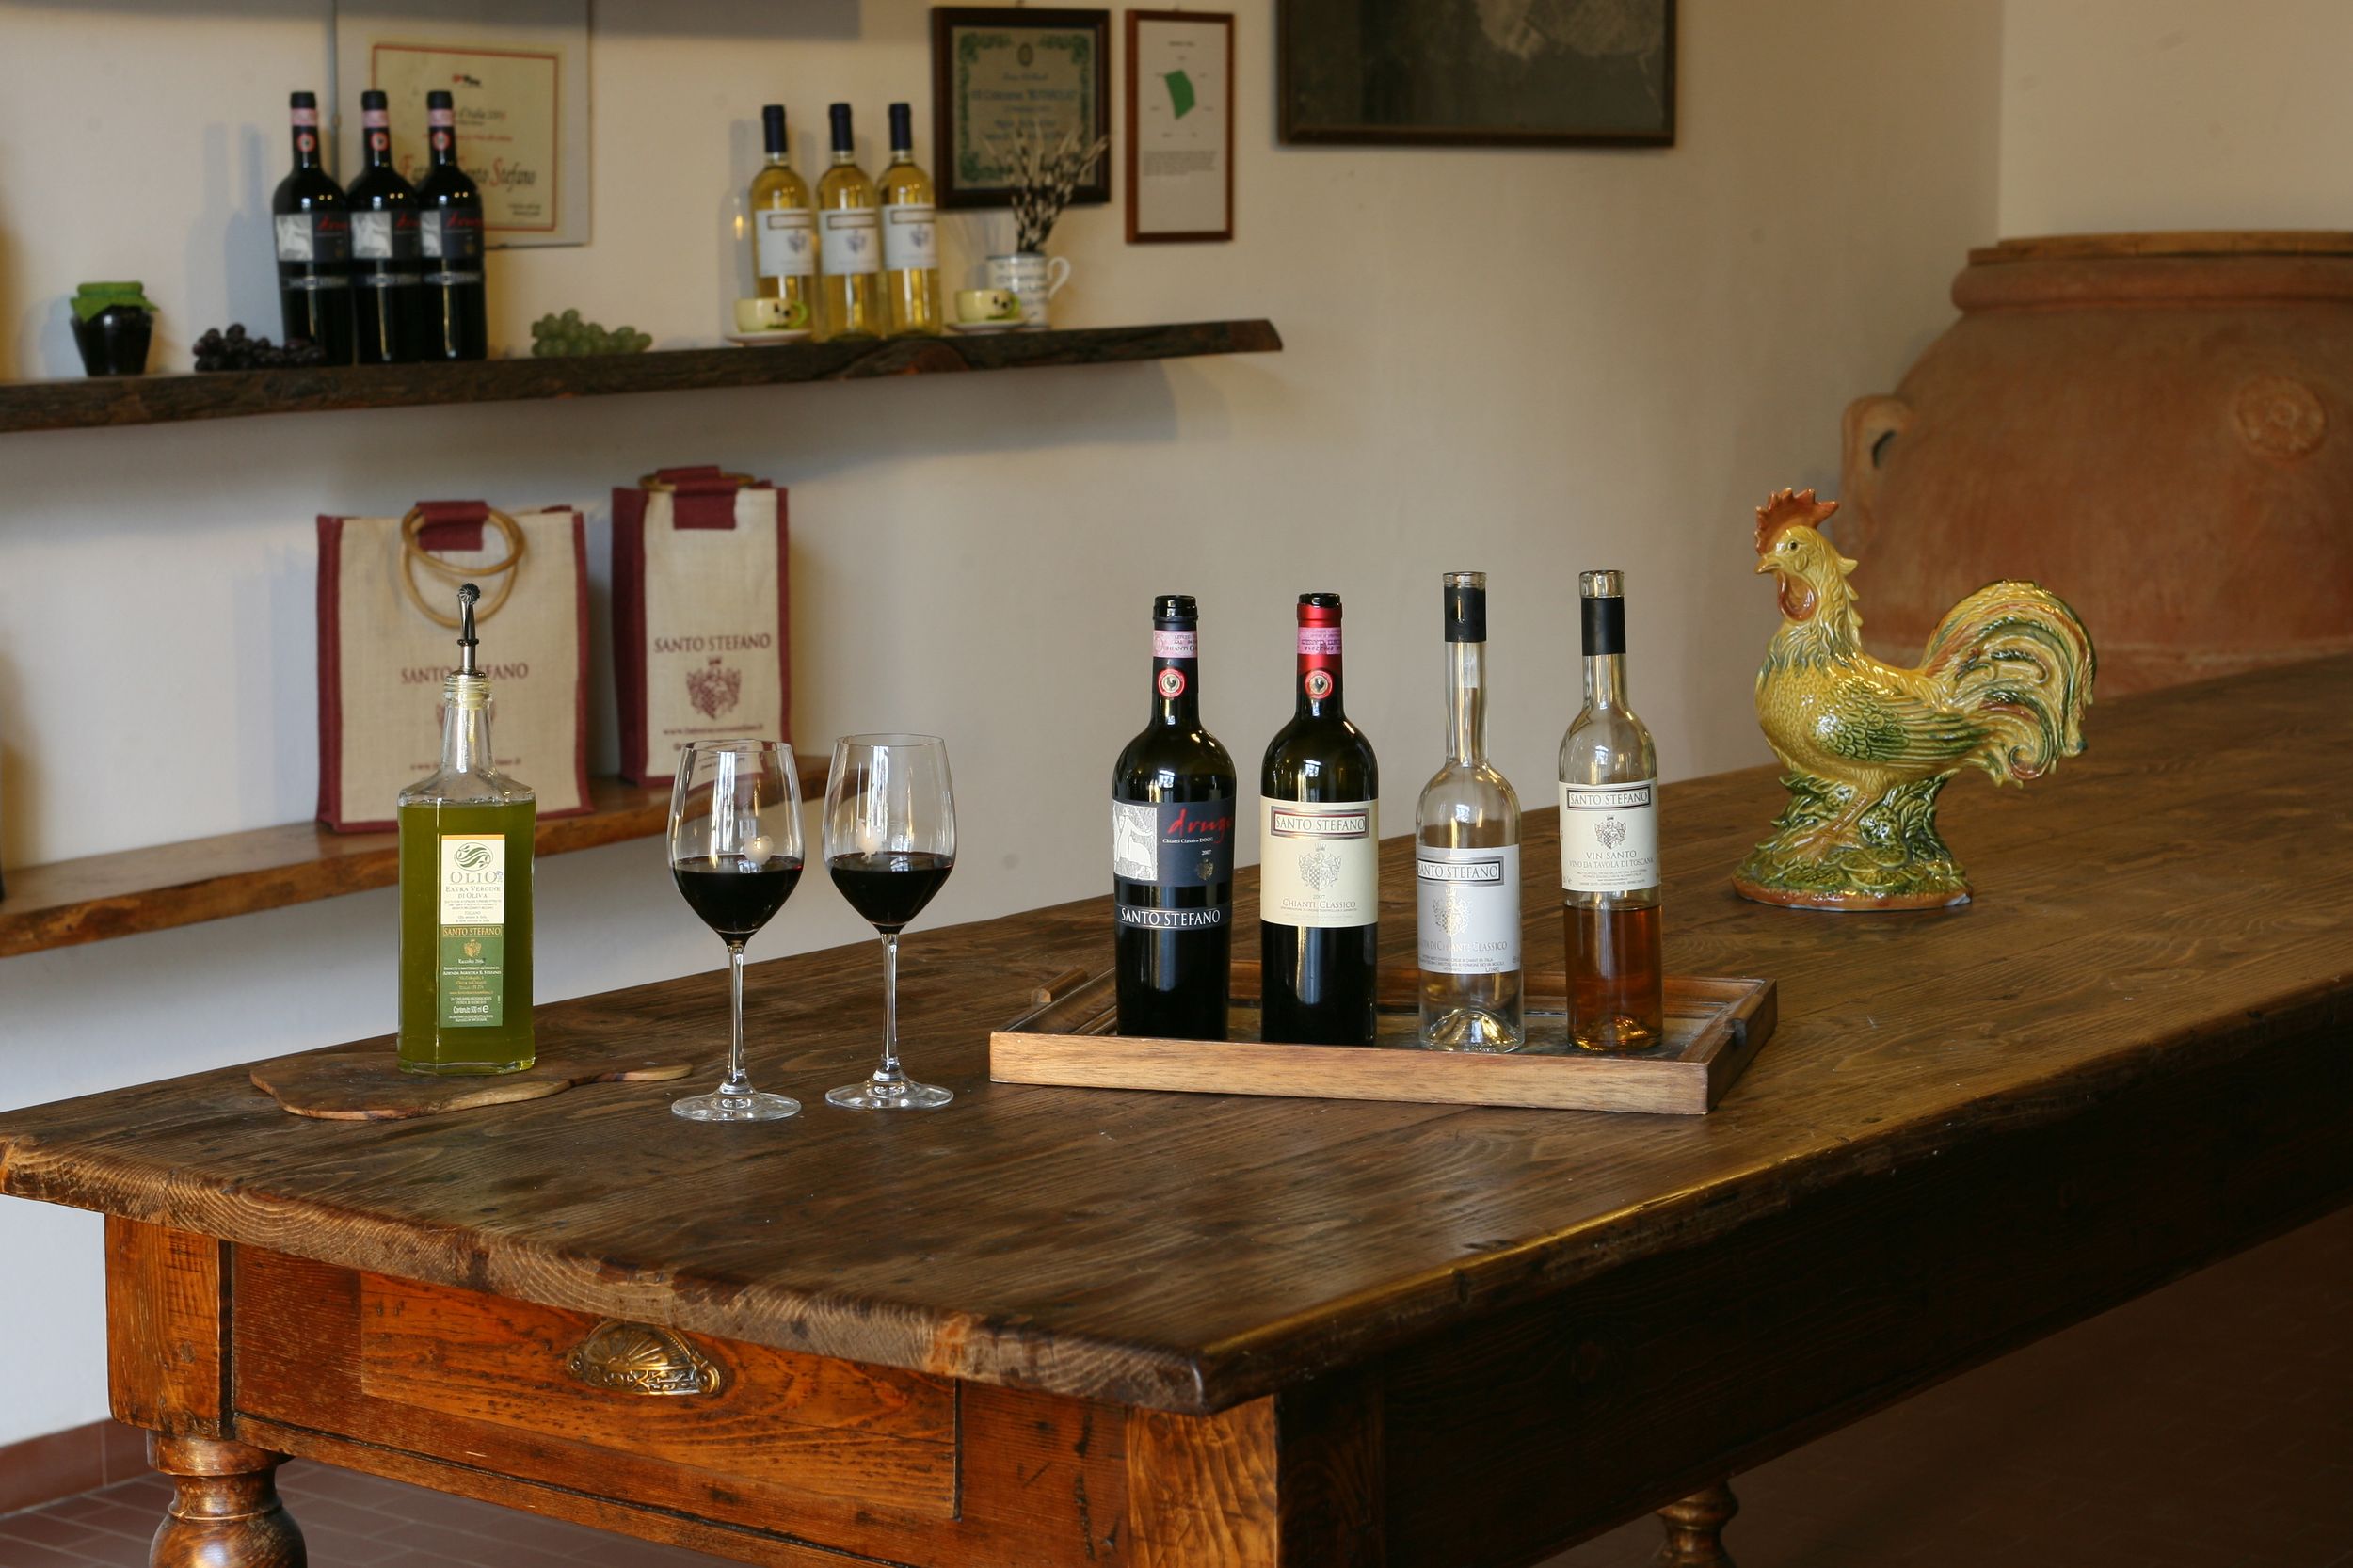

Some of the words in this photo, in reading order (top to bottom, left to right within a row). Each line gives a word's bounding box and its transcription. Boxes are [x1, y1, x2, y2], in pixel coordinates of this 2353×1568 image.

[654, 637, 704, 653] SANTO
[709, 632, 772, 651] STEFANO
[401, 665, 453, 684] SANTO
[1570, 793, 1602, 805] SANTO
[1605, 791, 1648, 805] STEFANO
[1276, 816, 1312, 829] SANTO
[1317, 818, 1366, 831] STEFANO
[1586, 852, 1603, 860] VIN
[1606, 849, 1637, 860] SANTO
[1594, 860, 1620, 869] TAVOLA
[450, 871, 497, 884] OLIO
[1447, 865, 1498, 879] STEFANO
[1282, 898, 1316, 909] CHIANTI
[1320, 900, 1356, 909] CLASSICO
[1121, 907, 1160, 925] SANTO
[1163, 909, 1221, 926] STEFANO
[443, 927, 469, 936] SANTO
[470, 927, 502, 936] STEFANO
[1473, 940, 1508, 952] CLASSICO
